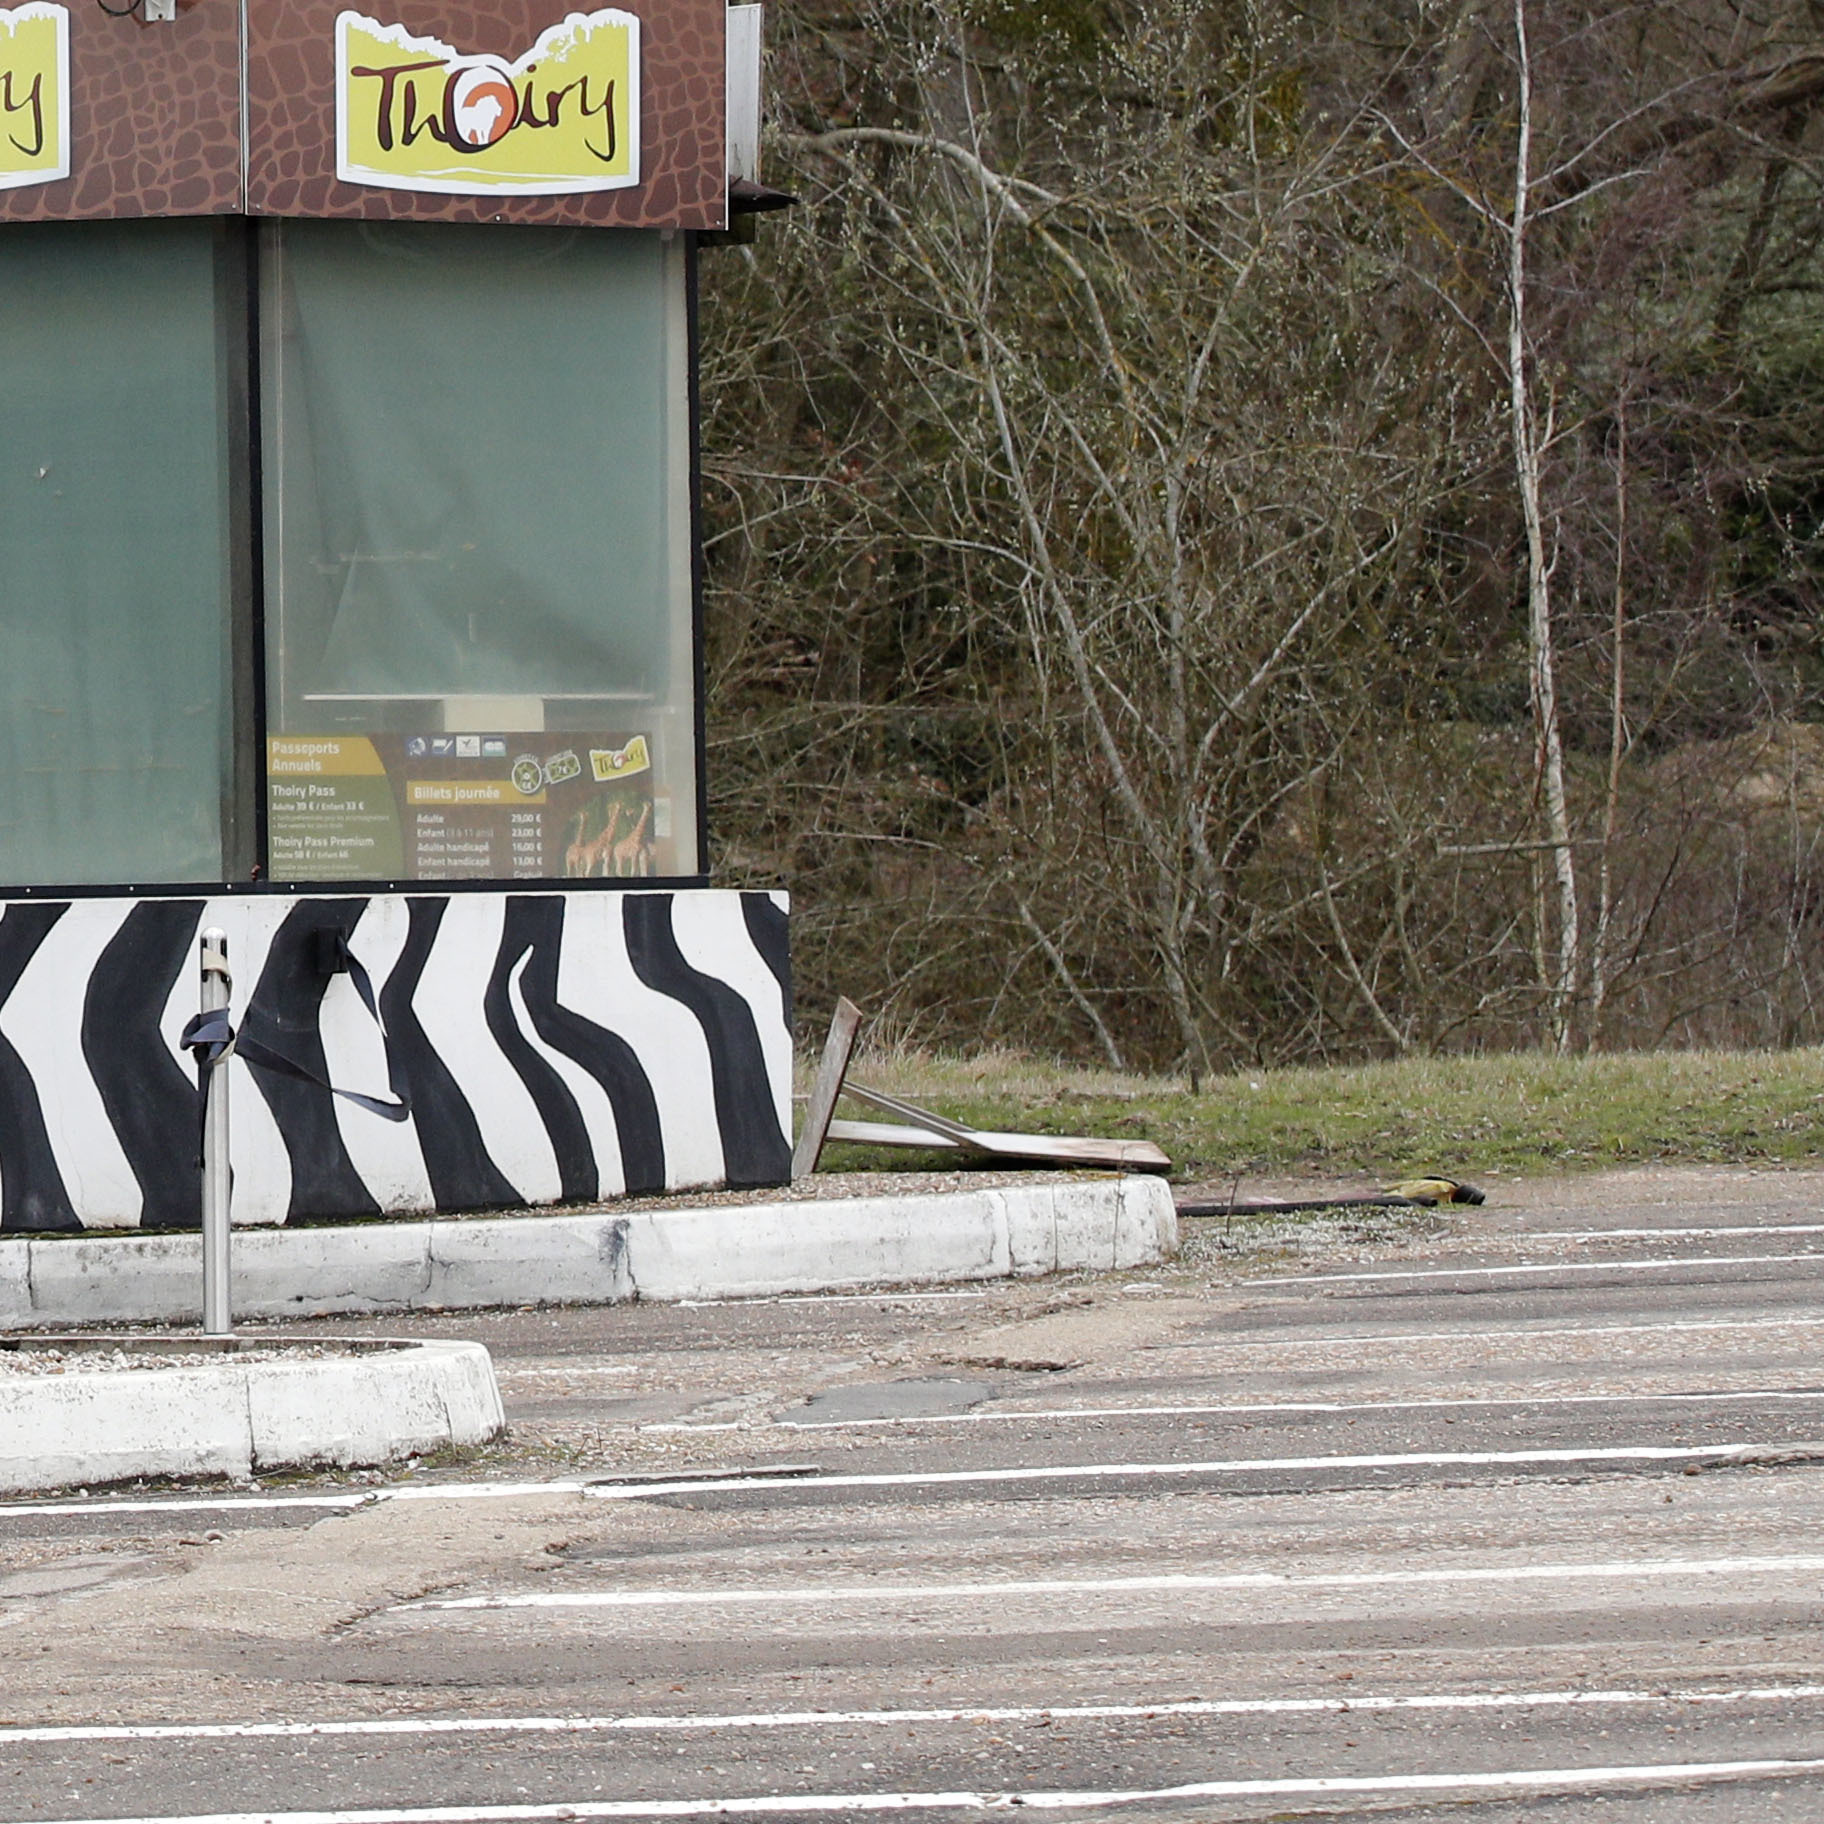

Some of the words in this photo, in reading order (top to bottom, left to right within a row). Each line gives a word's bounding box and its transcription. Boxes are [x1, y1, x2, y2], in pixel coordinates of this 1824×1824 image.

[352, 60, 615, 162] Thoiry
[272, 741, 340, 756] Passeports
[273, 759, 321, 771] Annuels
[272, 785, 305, 799] Thoiry
[309, 785, 335, 797] Pass
[414, 787, 452, 799] Billets
[455, 786, 500, 802] journée
